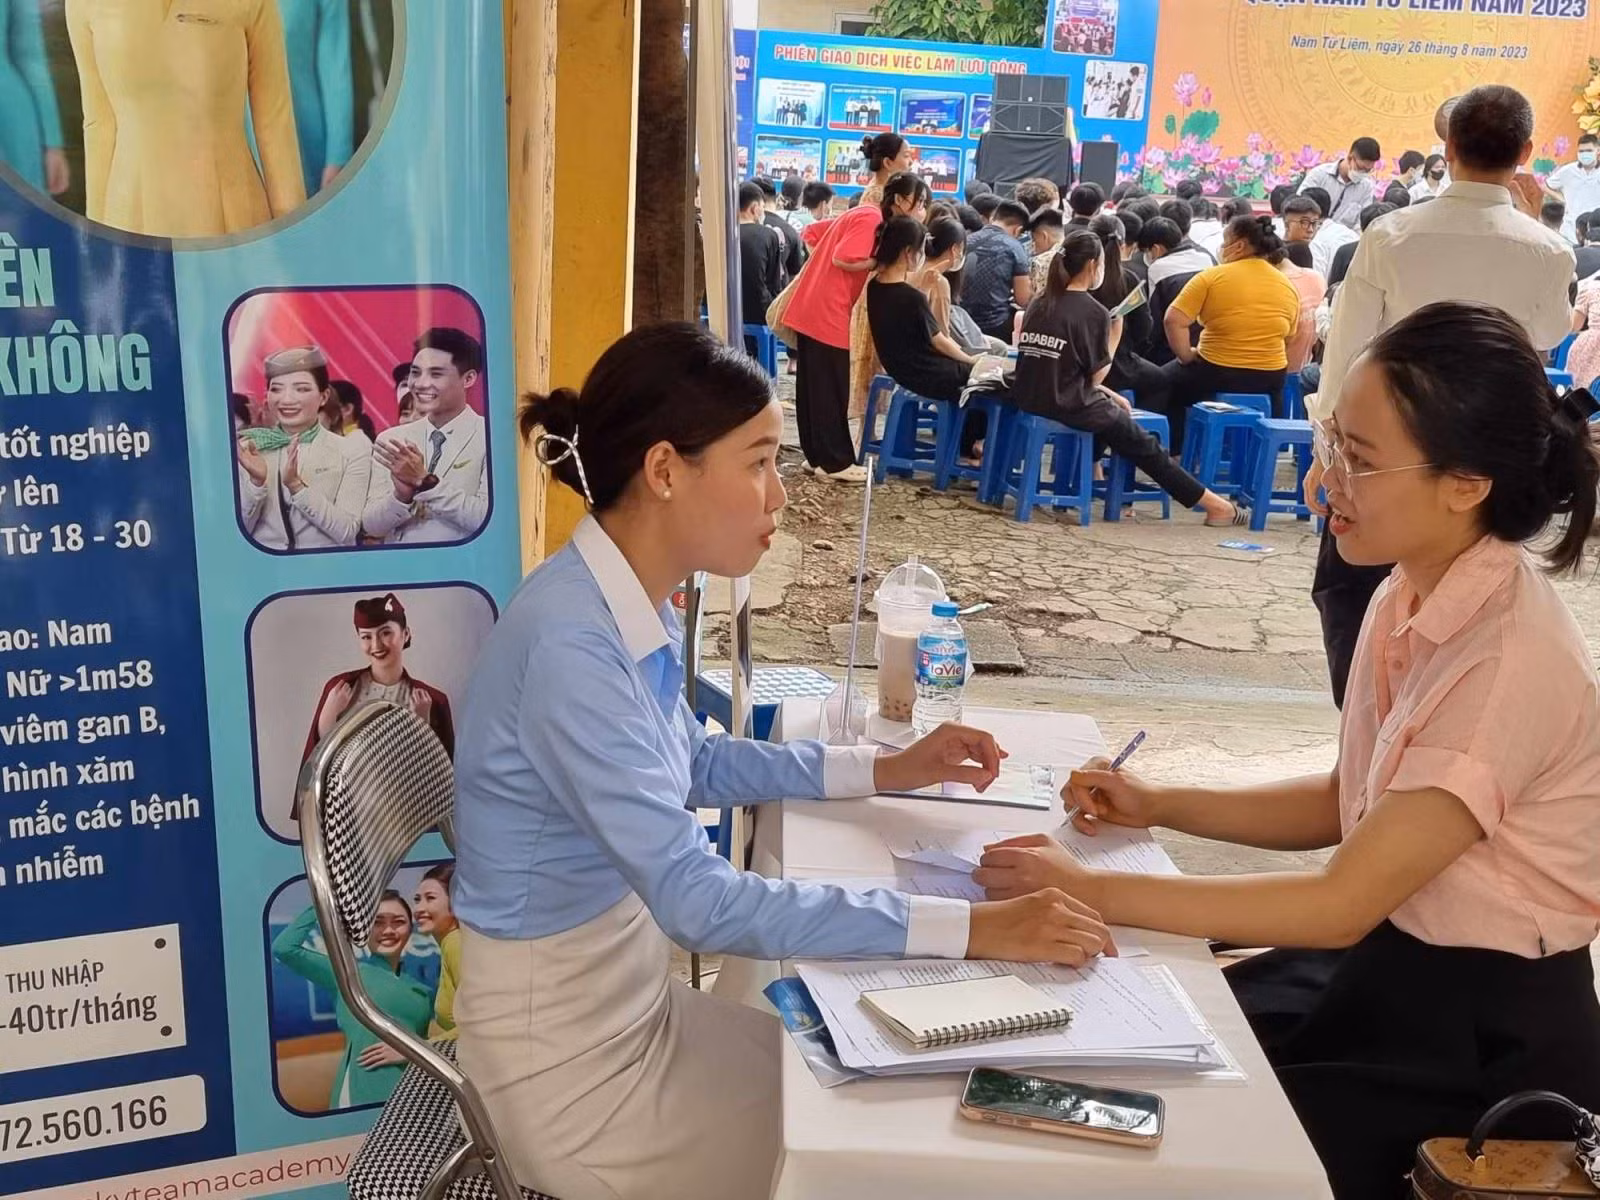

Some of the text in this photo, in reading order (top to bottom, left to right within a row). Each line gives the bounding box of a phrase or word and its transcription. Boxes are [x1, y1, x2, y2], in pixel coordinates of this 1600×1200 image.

[1530, 0, 1586, 17] 2023
[775, 44, 817, 61] PHIÊN
[821, 48, 852, 64] GIAO
[893, 52, 922, 72] VIỆC
[1291, 35, 1318, 49] Nam
[1408, 40, 1422, 54] 26
[1461, 43, 1469, 56] 8
[1500, 45, 1528, 59] 2023
[0, 422, 150, 461] tốt nghiệp
[14, 475, 59, 506] lên
[1, 524, 43, 555] Từ
[50, 523, 84, 552] 18
[114, 520, 151, 549] 30
[48, 619, 112, 647] Nam
[7, 660, 153, 698] Nữ >1m58
[0, 706, 166, 746] viêm gan B,
[3, 755, 134, 793] hình xăm
[9, 793, 200, 838] mắc các bệnh
[16, 845, 104, 884] nhiễm
[5, 959, 104, 994] THU NHẬP
[0, 1095, 167, 1151] 72.560.166
